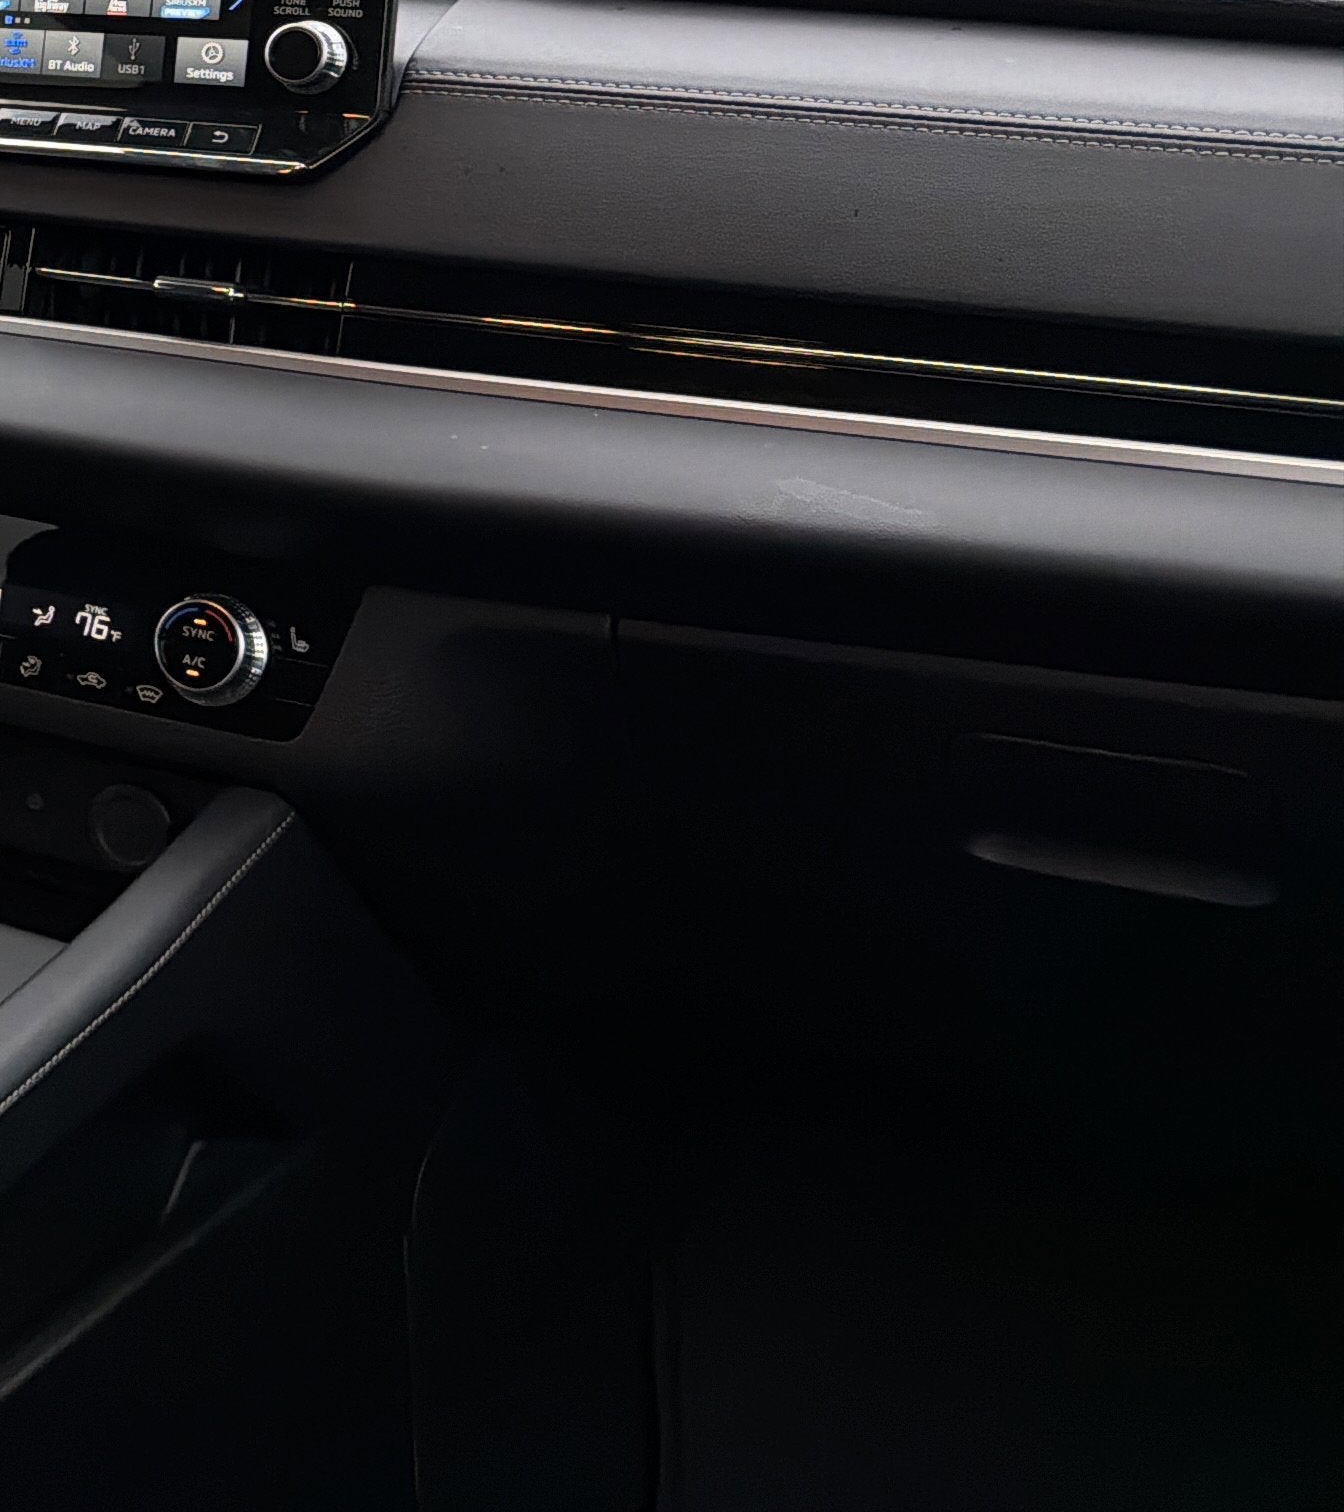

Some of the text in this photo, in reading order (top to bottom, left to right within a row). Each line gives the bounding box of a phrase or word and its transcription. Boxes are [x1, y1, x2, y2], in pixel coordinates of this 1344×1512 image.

[273, 6, 310, 16] SCROLL
[328, 8, 363, 18] SOUND
[48, 60, 94, 72] BT Audio
[117, 64, 145, 74] USB1
[186, 67, 234, 82] Settings
[128, 126, 176, 138] CAMERA
[84, 603, 109, 616] SYNC
[182, 625, 215, 641] SYNC
[182, 654, 206, 669] A/C
